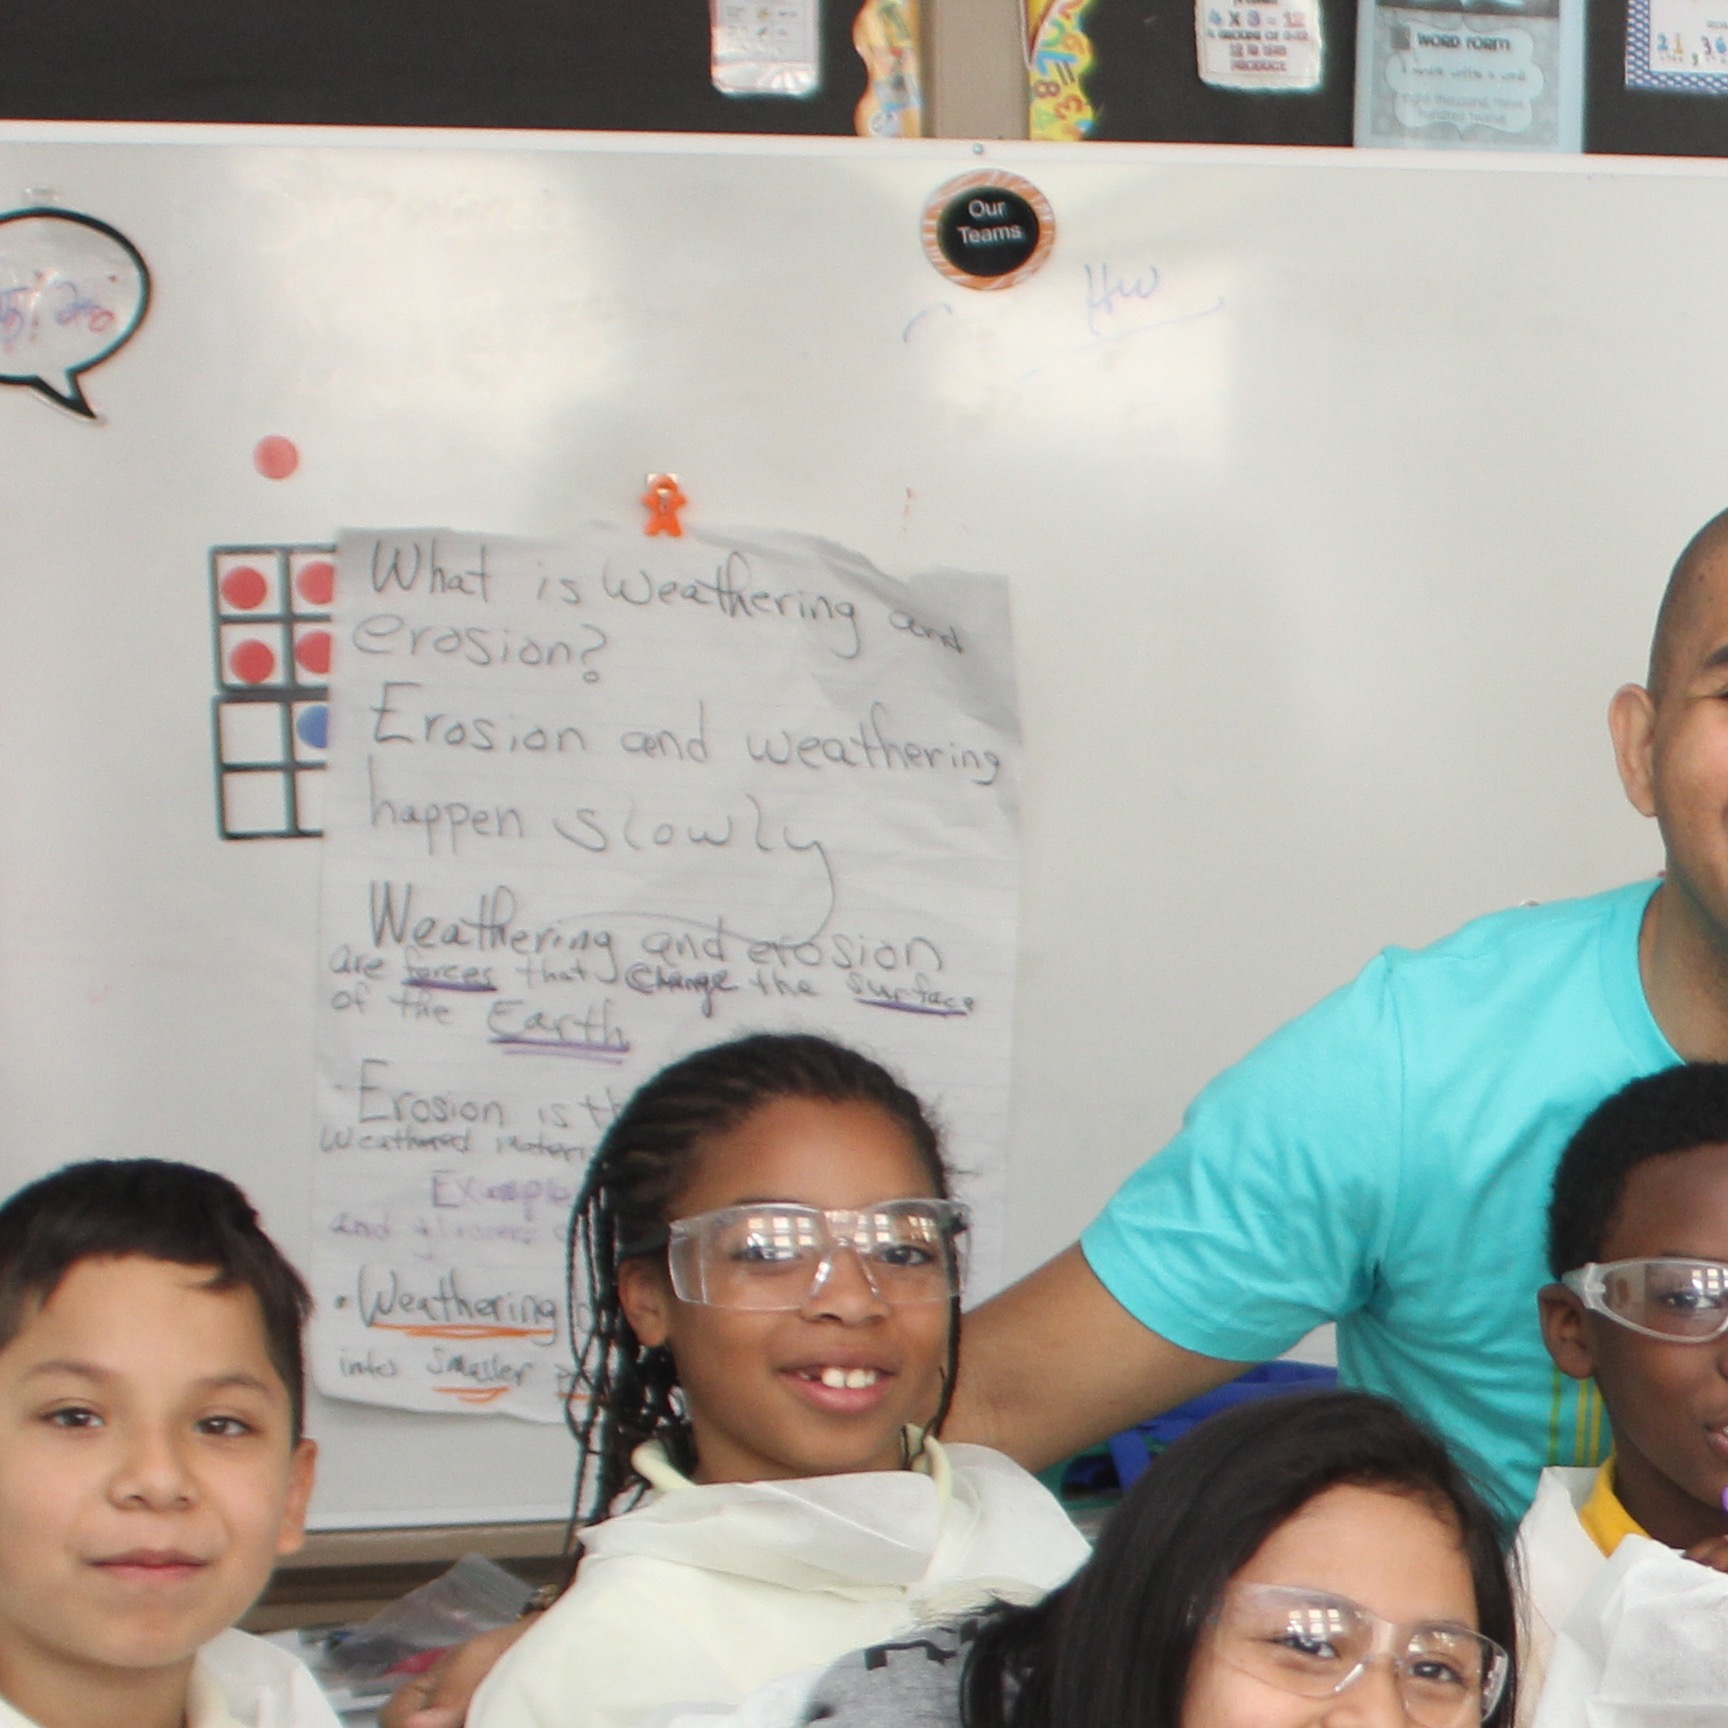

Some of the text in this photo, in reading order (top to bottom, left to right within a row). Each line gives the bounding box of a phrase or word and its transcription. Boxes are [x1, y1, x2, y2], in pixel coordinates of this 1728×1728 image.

[957, 223, 1023, 245] Teams
[968, 199, 1006, 218] Our
[372, 539, 492, 597] What
[536, 560, 584, 606] is
[890, 609, 968, 656] and
[352, 609, 610, 685] erosion?
[372, 680, 1003, 787] Erosion and weathering
[367, 756, 527, 856] happen
[369, 881, 943, 983] Weathering and erosion
[328, 944, 384, 979] are
[515, 952, 585, 989] that
[750, 967, 819, 997] the
[330, 981, 630, 1052] of the Earth
[358, 1057, 569, 1129] Erosion is
[358, 1263, 557, 1347] Weathering
